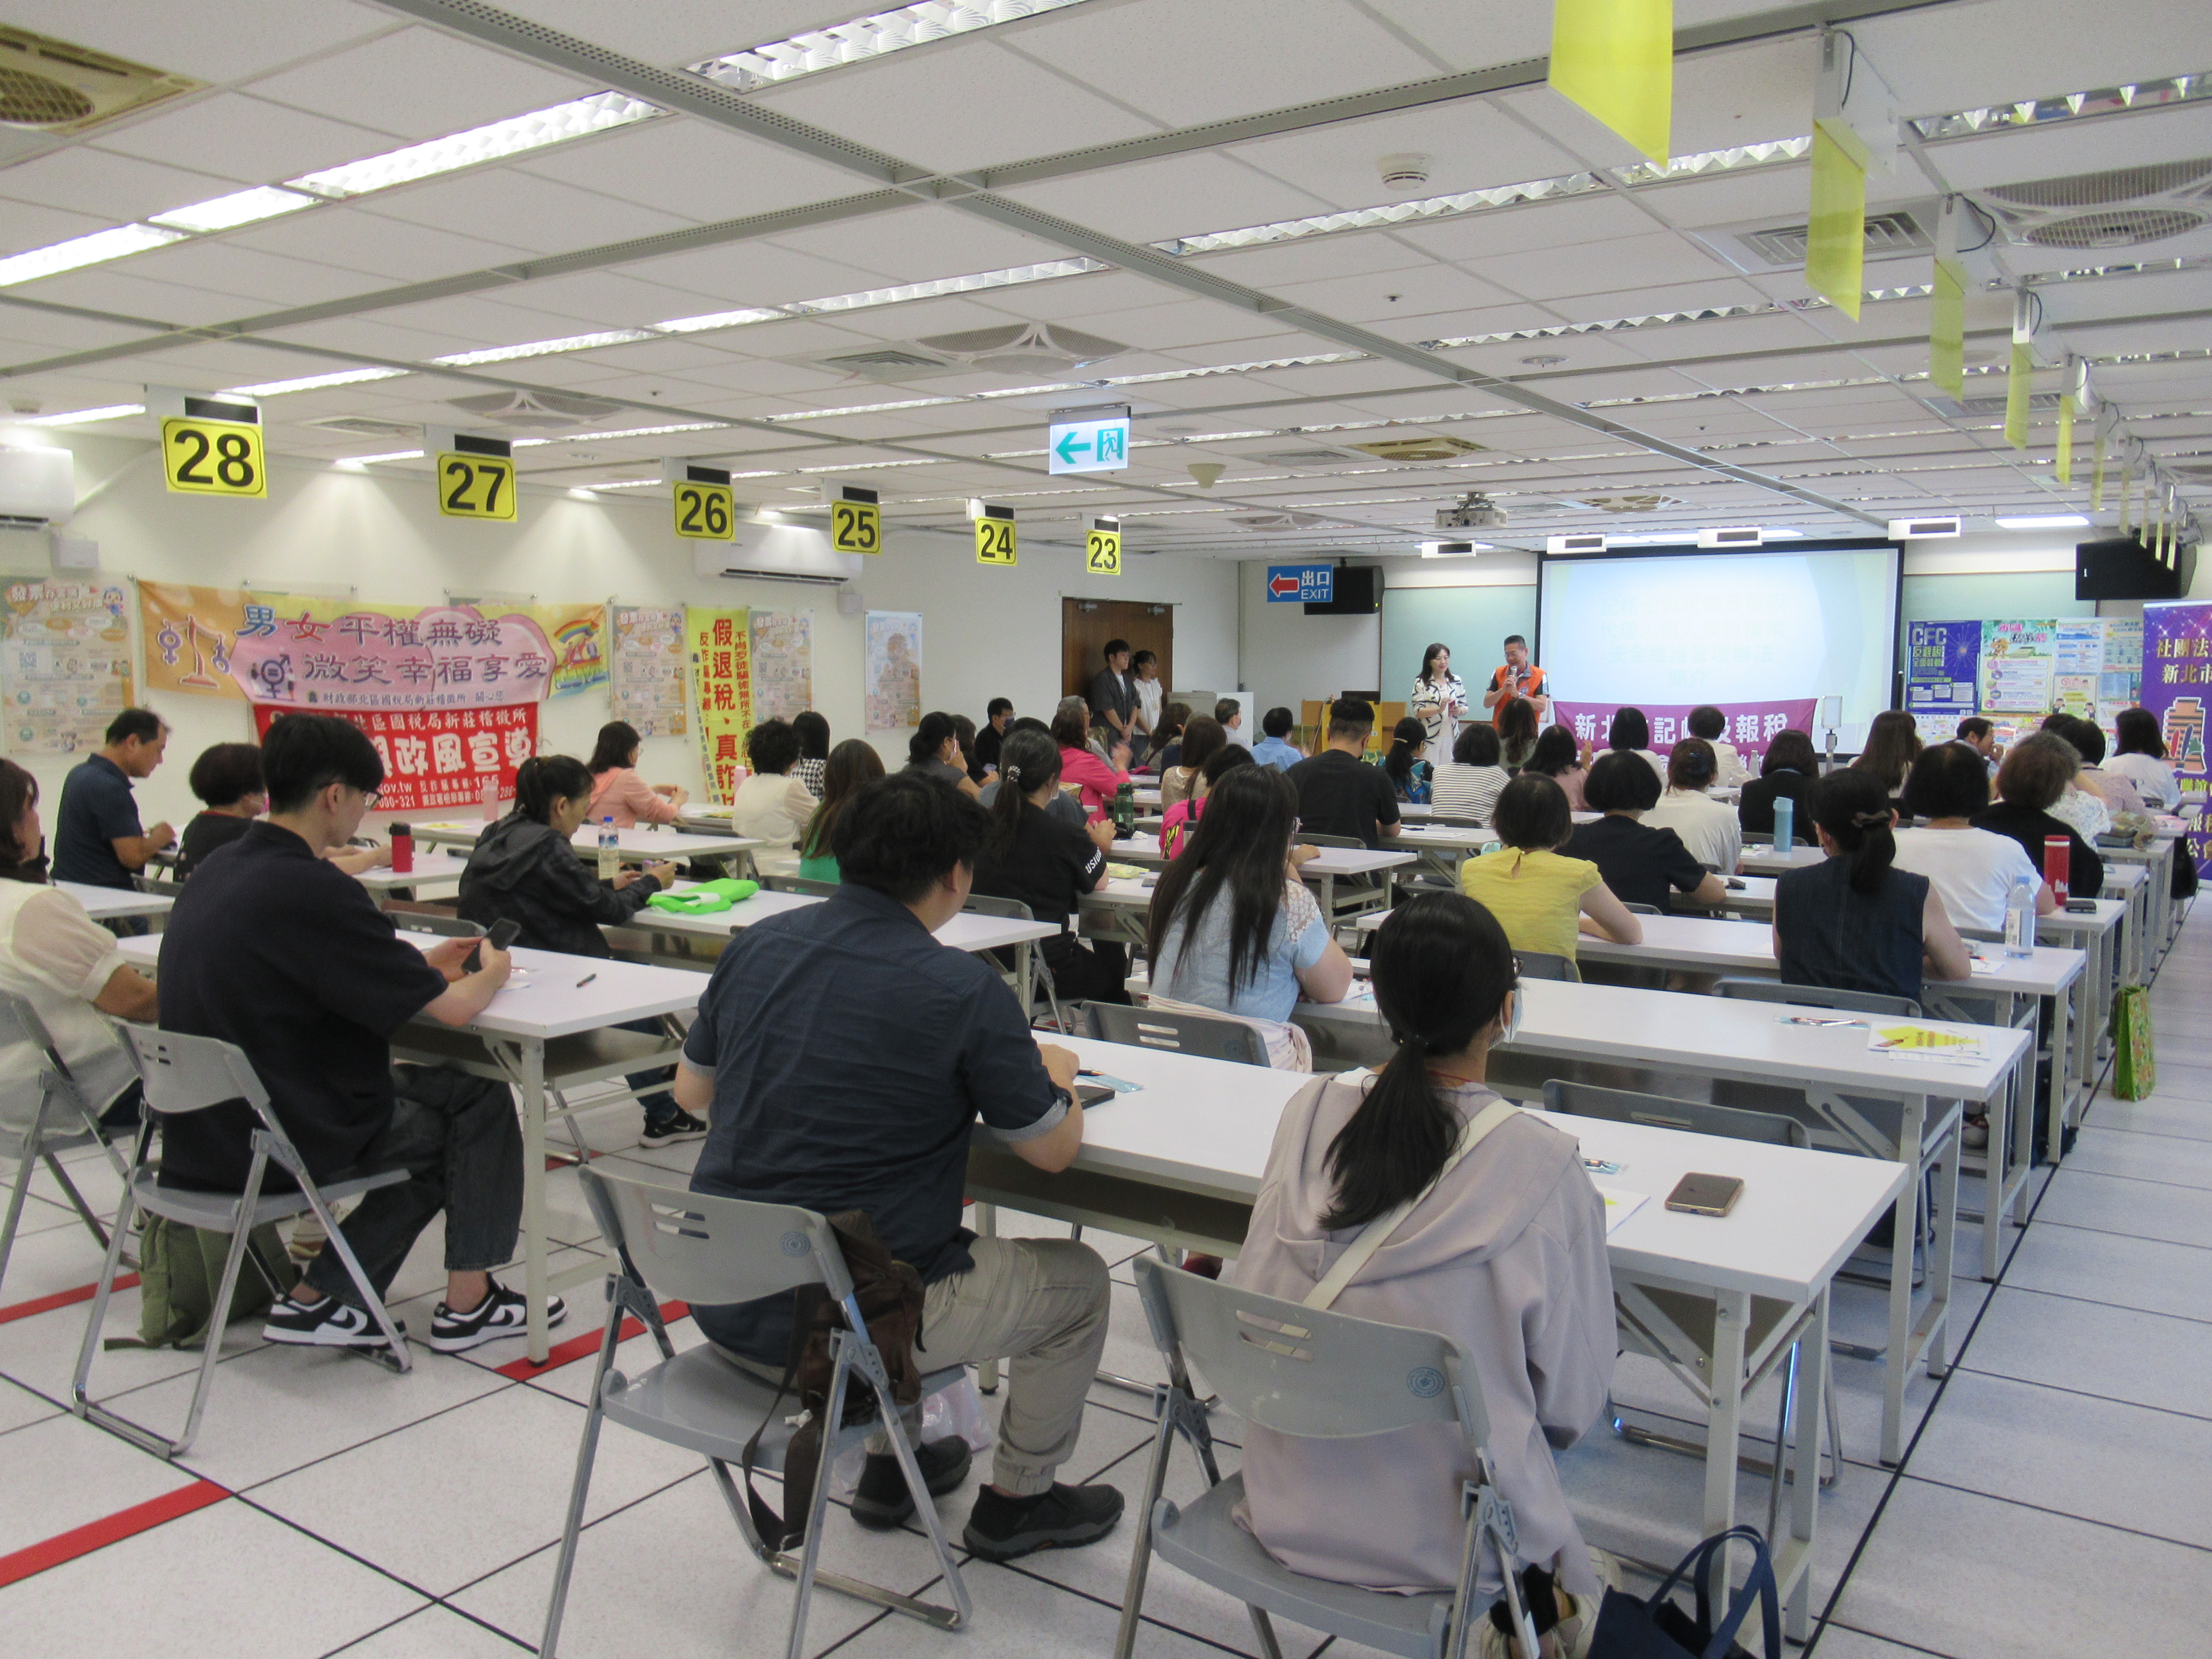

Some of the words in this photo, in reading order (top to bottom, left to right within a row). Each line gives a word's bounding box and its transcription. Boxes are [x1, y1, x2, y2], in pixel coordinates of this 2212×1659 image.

[174, 429, 254, 487] 28
[446, 462, 506, 512] 27
[680, 490, 728, 534] 26
[838, 508, 875, 548] 25
[981, 524, 1013, 559] 24
[1091, 536, 1116, 569] 23
[1301, 570, 1330, 587] 出口
[1301, 589, 1329, 599] EXIT
[235, 604, 504, 648] 男女平權無礙
[1912, 628, 1947, 646] CFC
[2156, 637, 2212, 658] 社團法
[303, 652, 548, 684] 微笑幸福享愛
[1575, 713, 1787, 744] 新北記報稅
